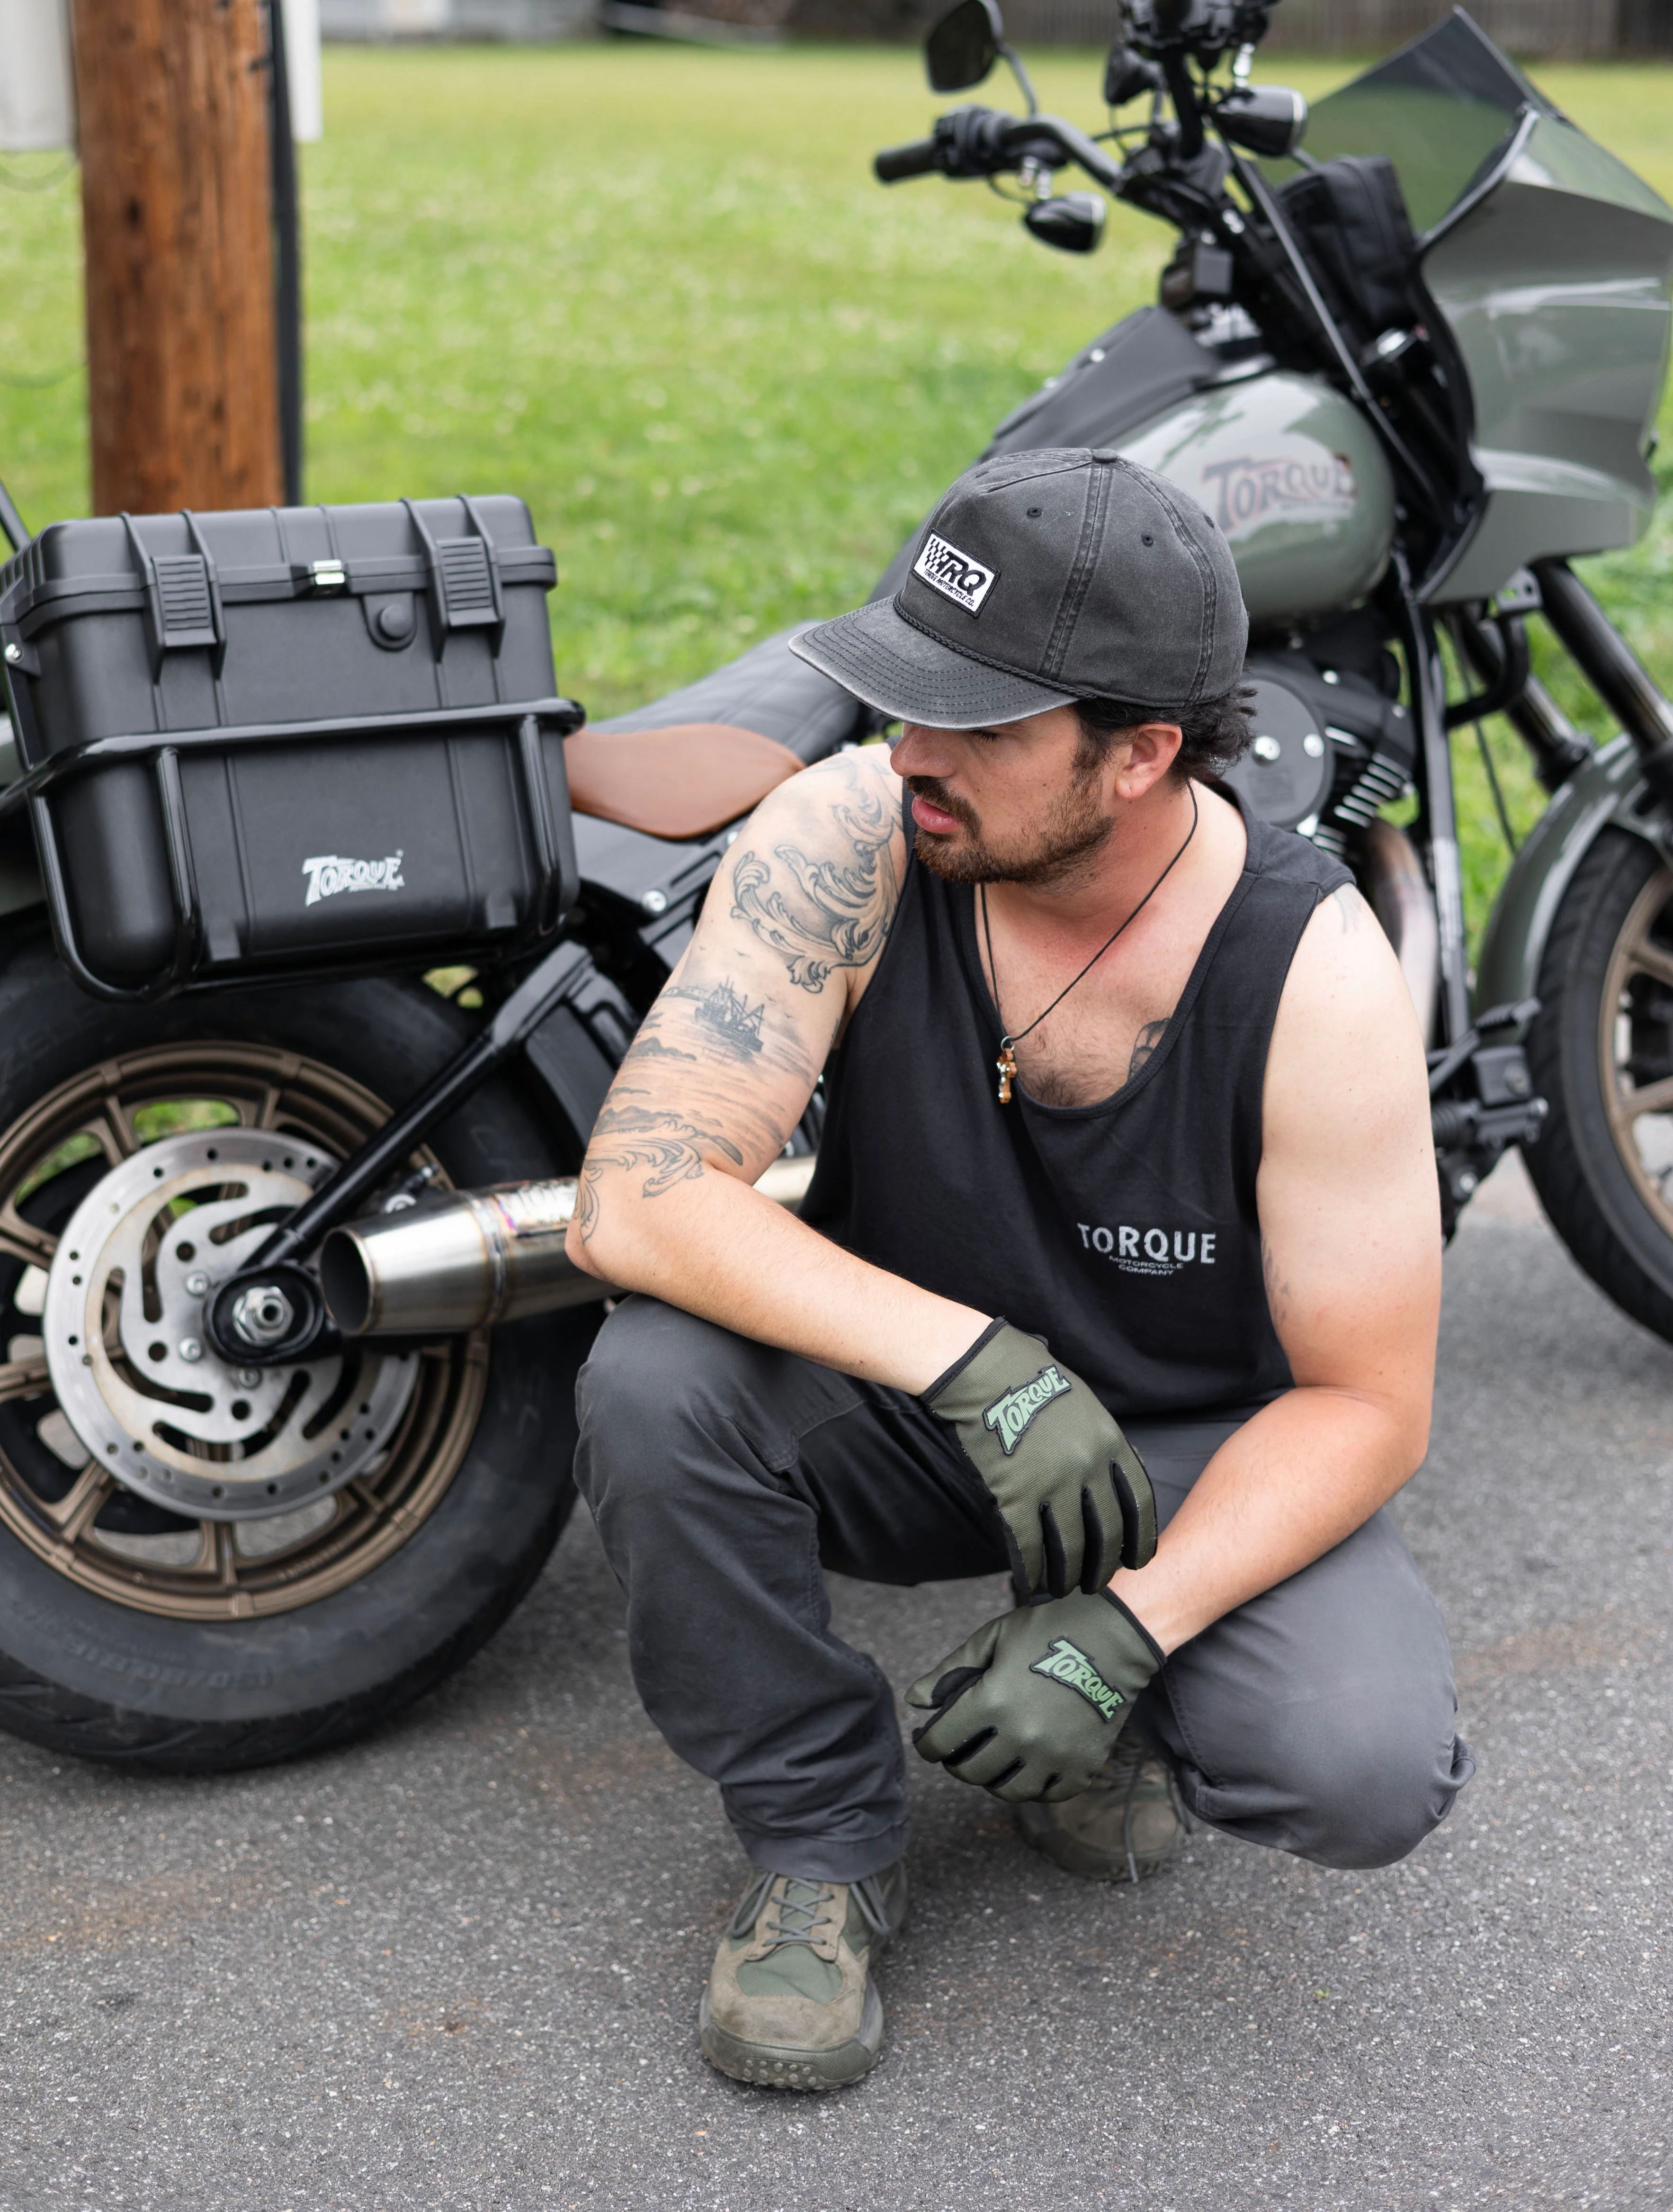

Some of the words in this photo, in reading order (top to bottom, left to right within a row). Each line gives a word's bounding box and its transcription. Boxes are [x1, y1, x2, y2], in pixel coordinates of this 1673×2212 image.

[1200, 455, 1358, 531] TORQUE
[936, 550, 987, 596] TRQ
[936, 577, 967, 600] MOTORCYCLE
[302, 854, 405, 907] TORQUE
[1077, 1223, 1217, 1265] TORQUE
[1109, 1255, 1184, 1269] MOTORCYCLE
[1118, 1264, 1174, 1276] COMPANY
[986, 1367, 1071, 1451] TORQUE
[1033, 1639, 1124, 1719] TORQUE
